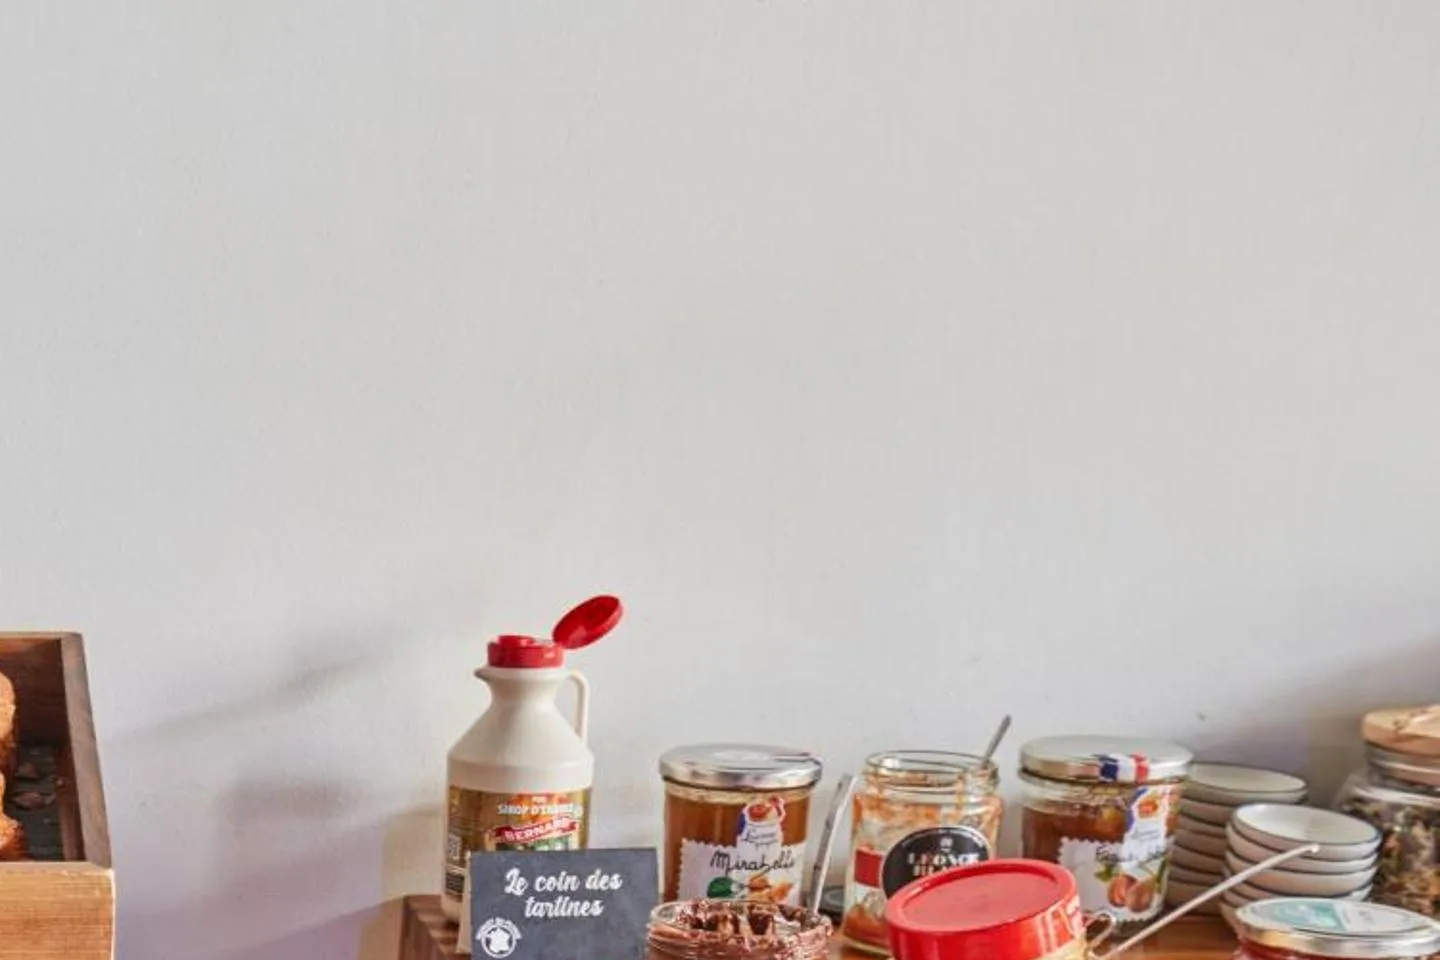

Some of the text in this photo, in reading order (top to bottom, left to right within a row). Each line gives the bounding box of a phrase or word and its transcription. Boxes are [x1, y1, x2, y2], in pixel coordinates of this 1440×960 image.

[504, 867, 624, 896] Le coin des
[524, 896, 605, 918] tartines
